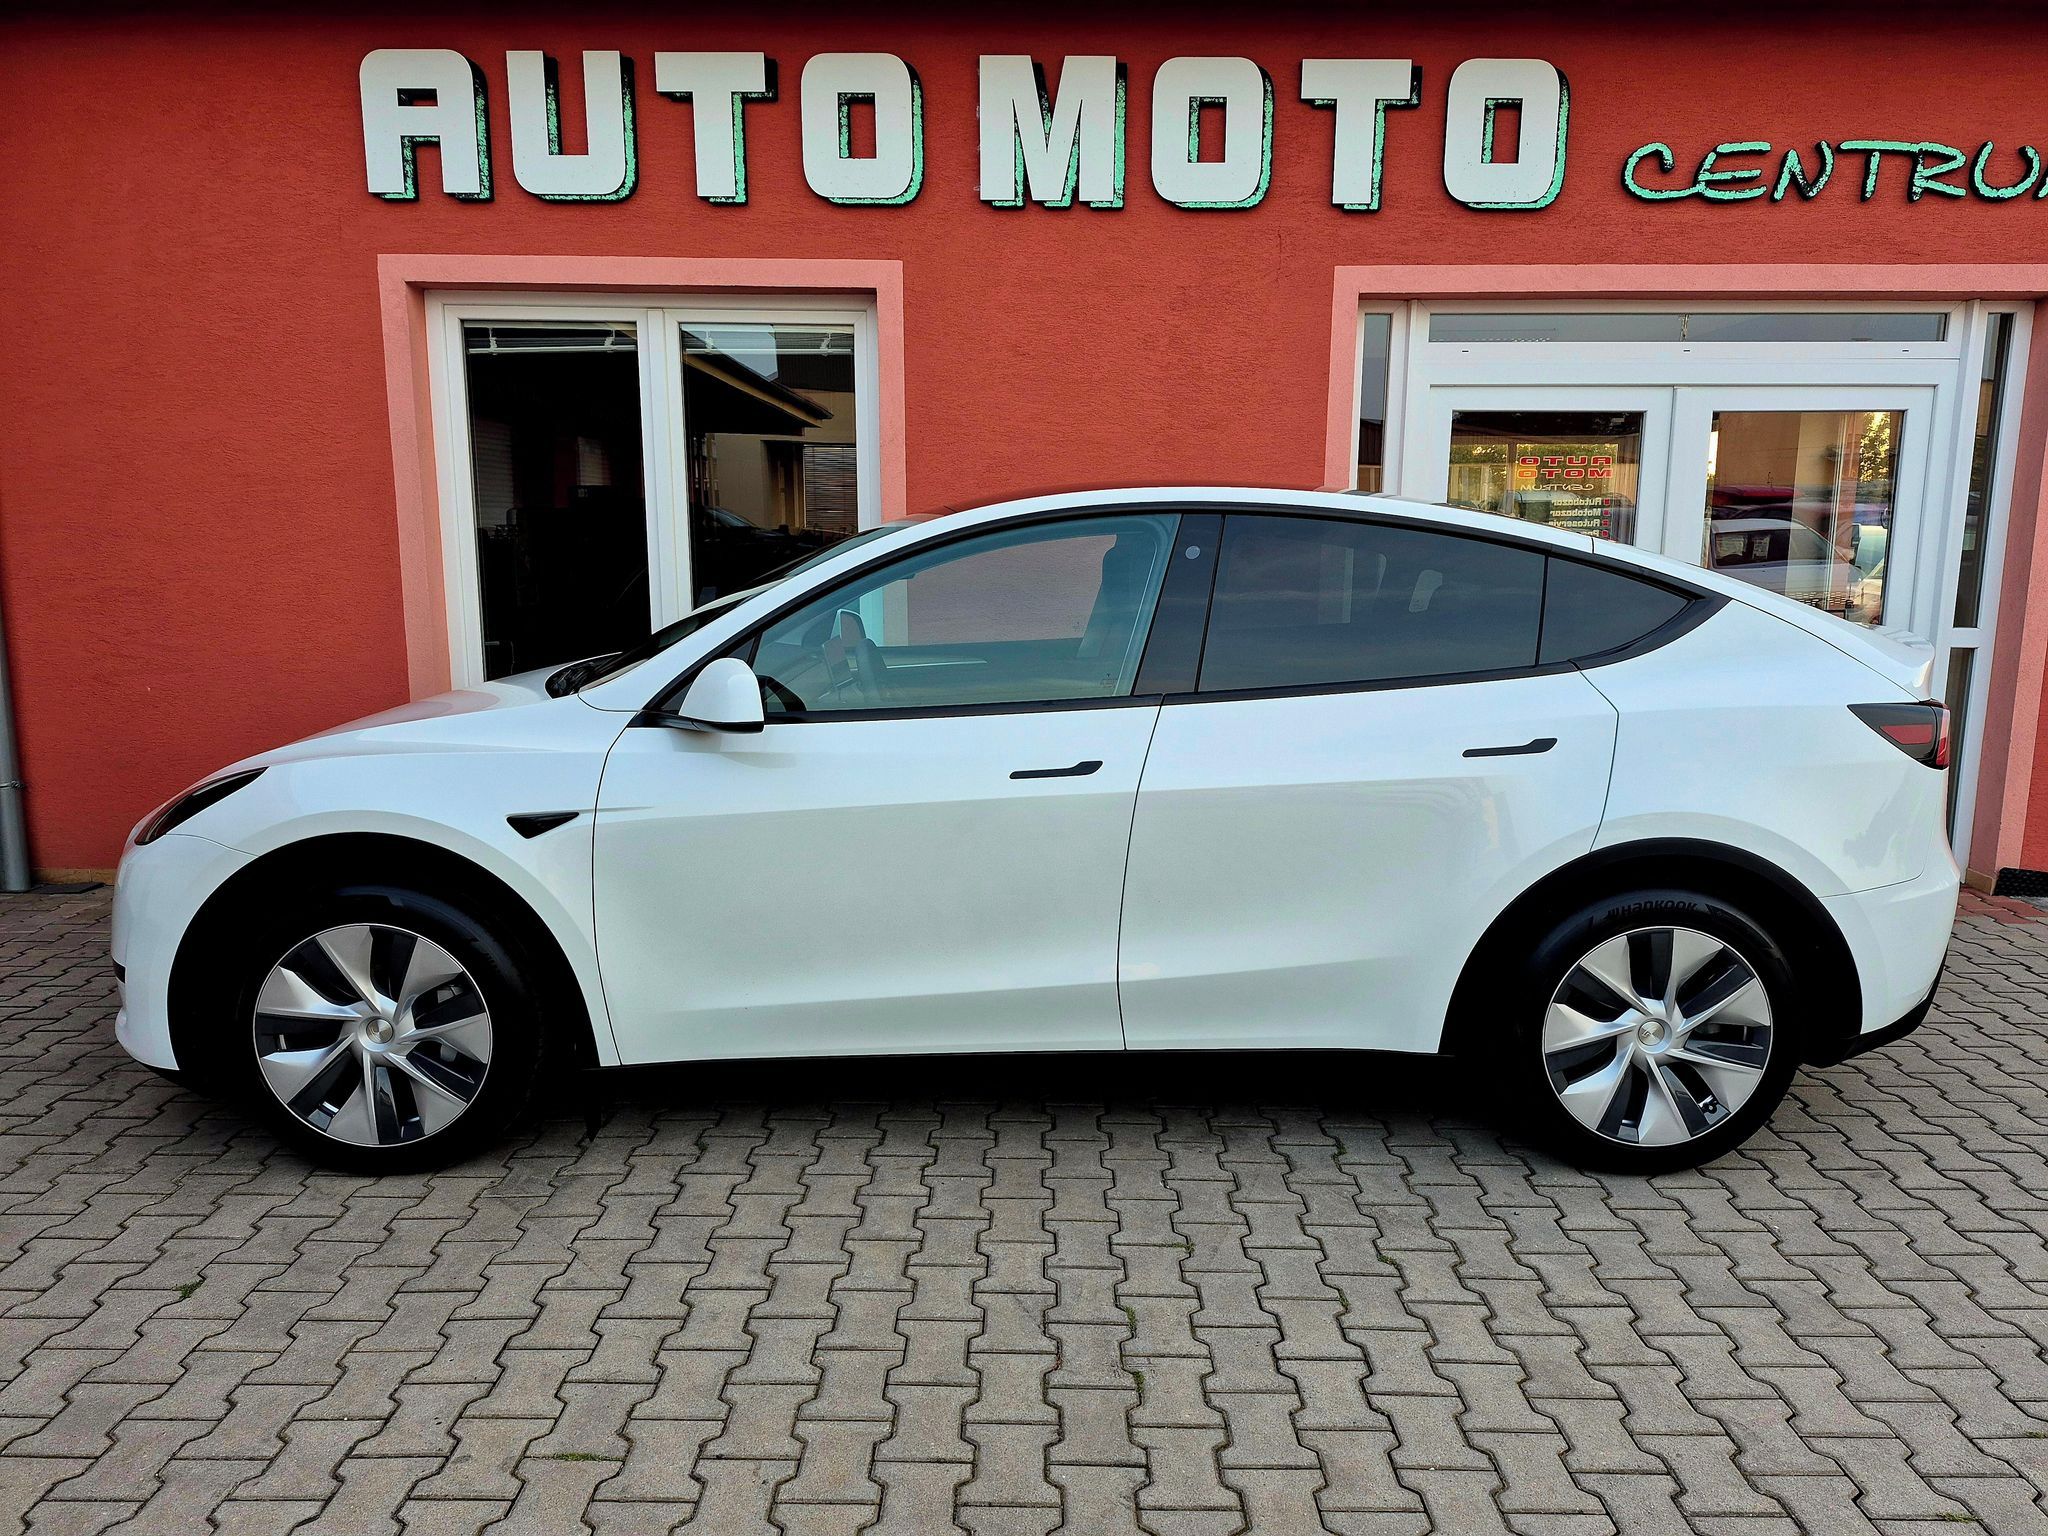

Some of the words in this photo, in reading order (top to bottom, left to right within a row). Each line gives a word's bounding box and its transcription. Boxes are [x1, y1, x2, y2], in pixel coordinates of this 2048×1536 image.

[359, 48, 923, 204] AUTO
[978, 54, 1570, 211] MOTO
[1621, 140, 2048, 202] CENTRU
